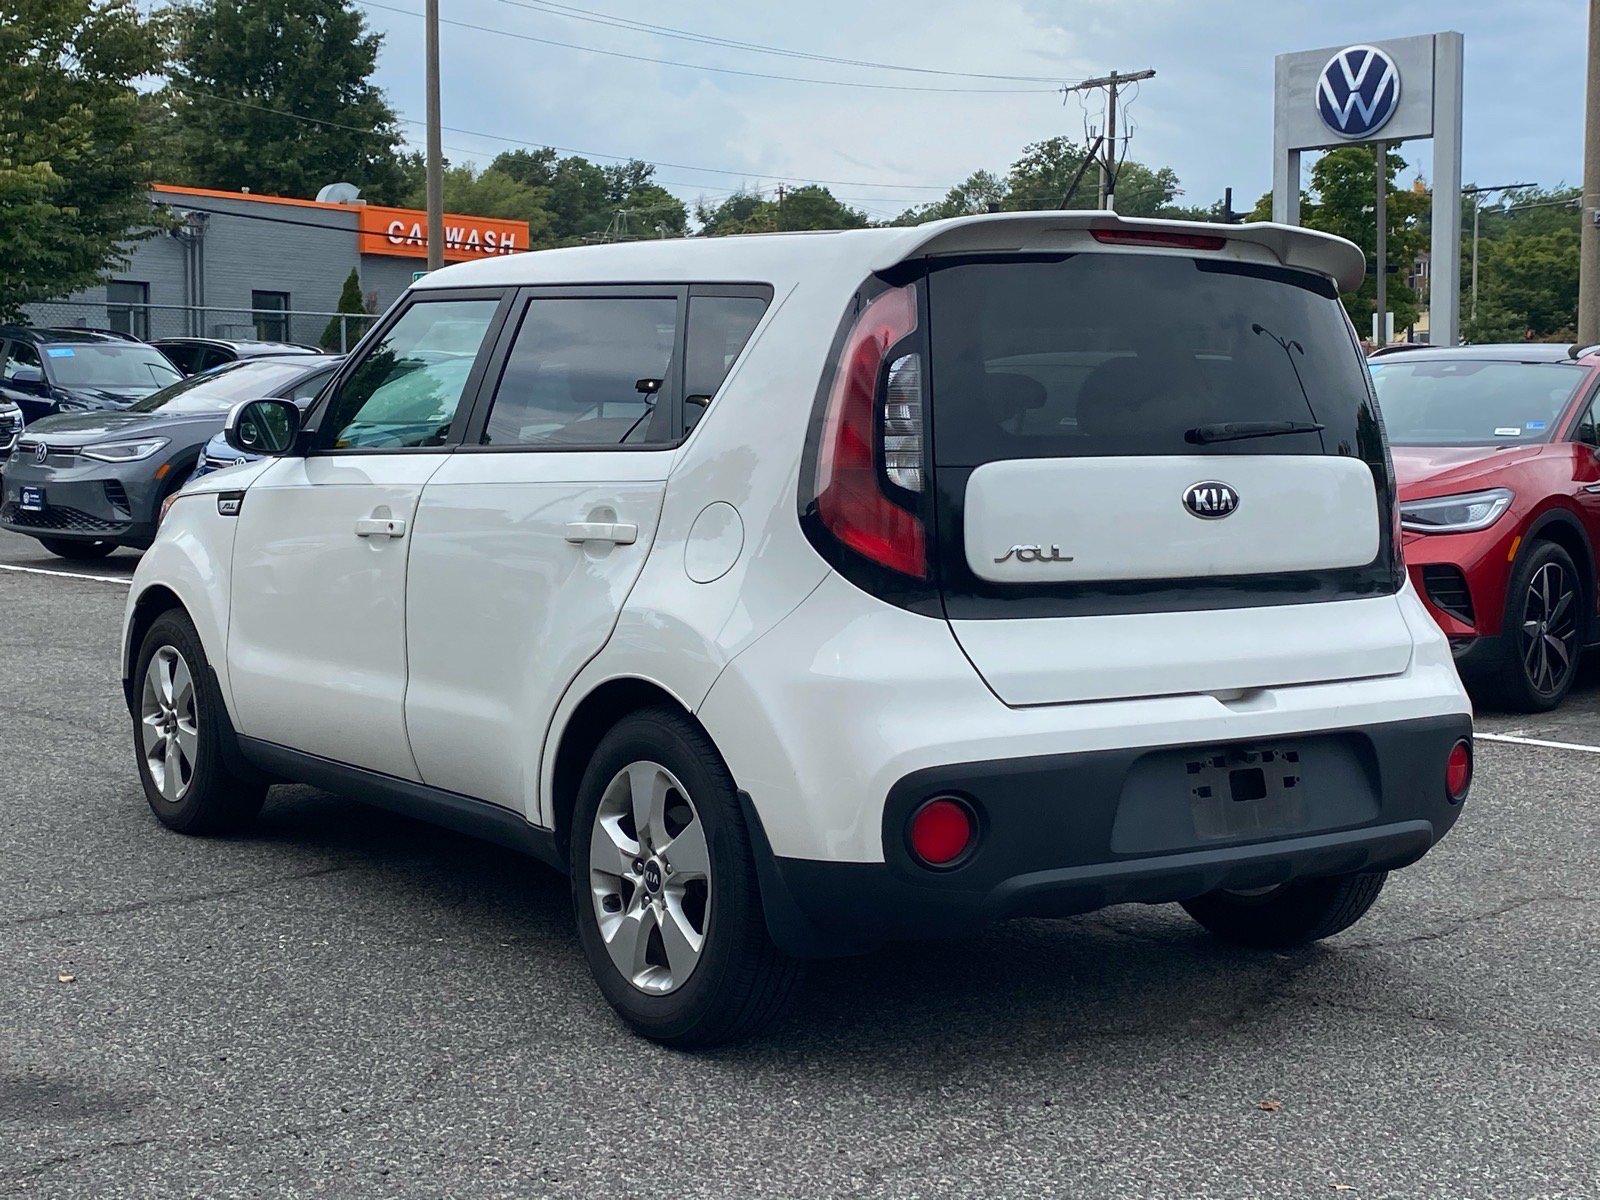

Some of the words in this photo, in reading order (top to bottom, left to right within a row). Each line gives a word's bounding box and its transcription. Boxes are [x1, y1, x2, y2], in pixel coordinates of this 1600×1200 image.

[1317, 46, 1398, 135] VW
[387, 220, 428, 247] CA
[445, 226, 515, 254] WASH
[1193, 488, 1233, 511] KIA
[645, 870, 659, 885] KIA
